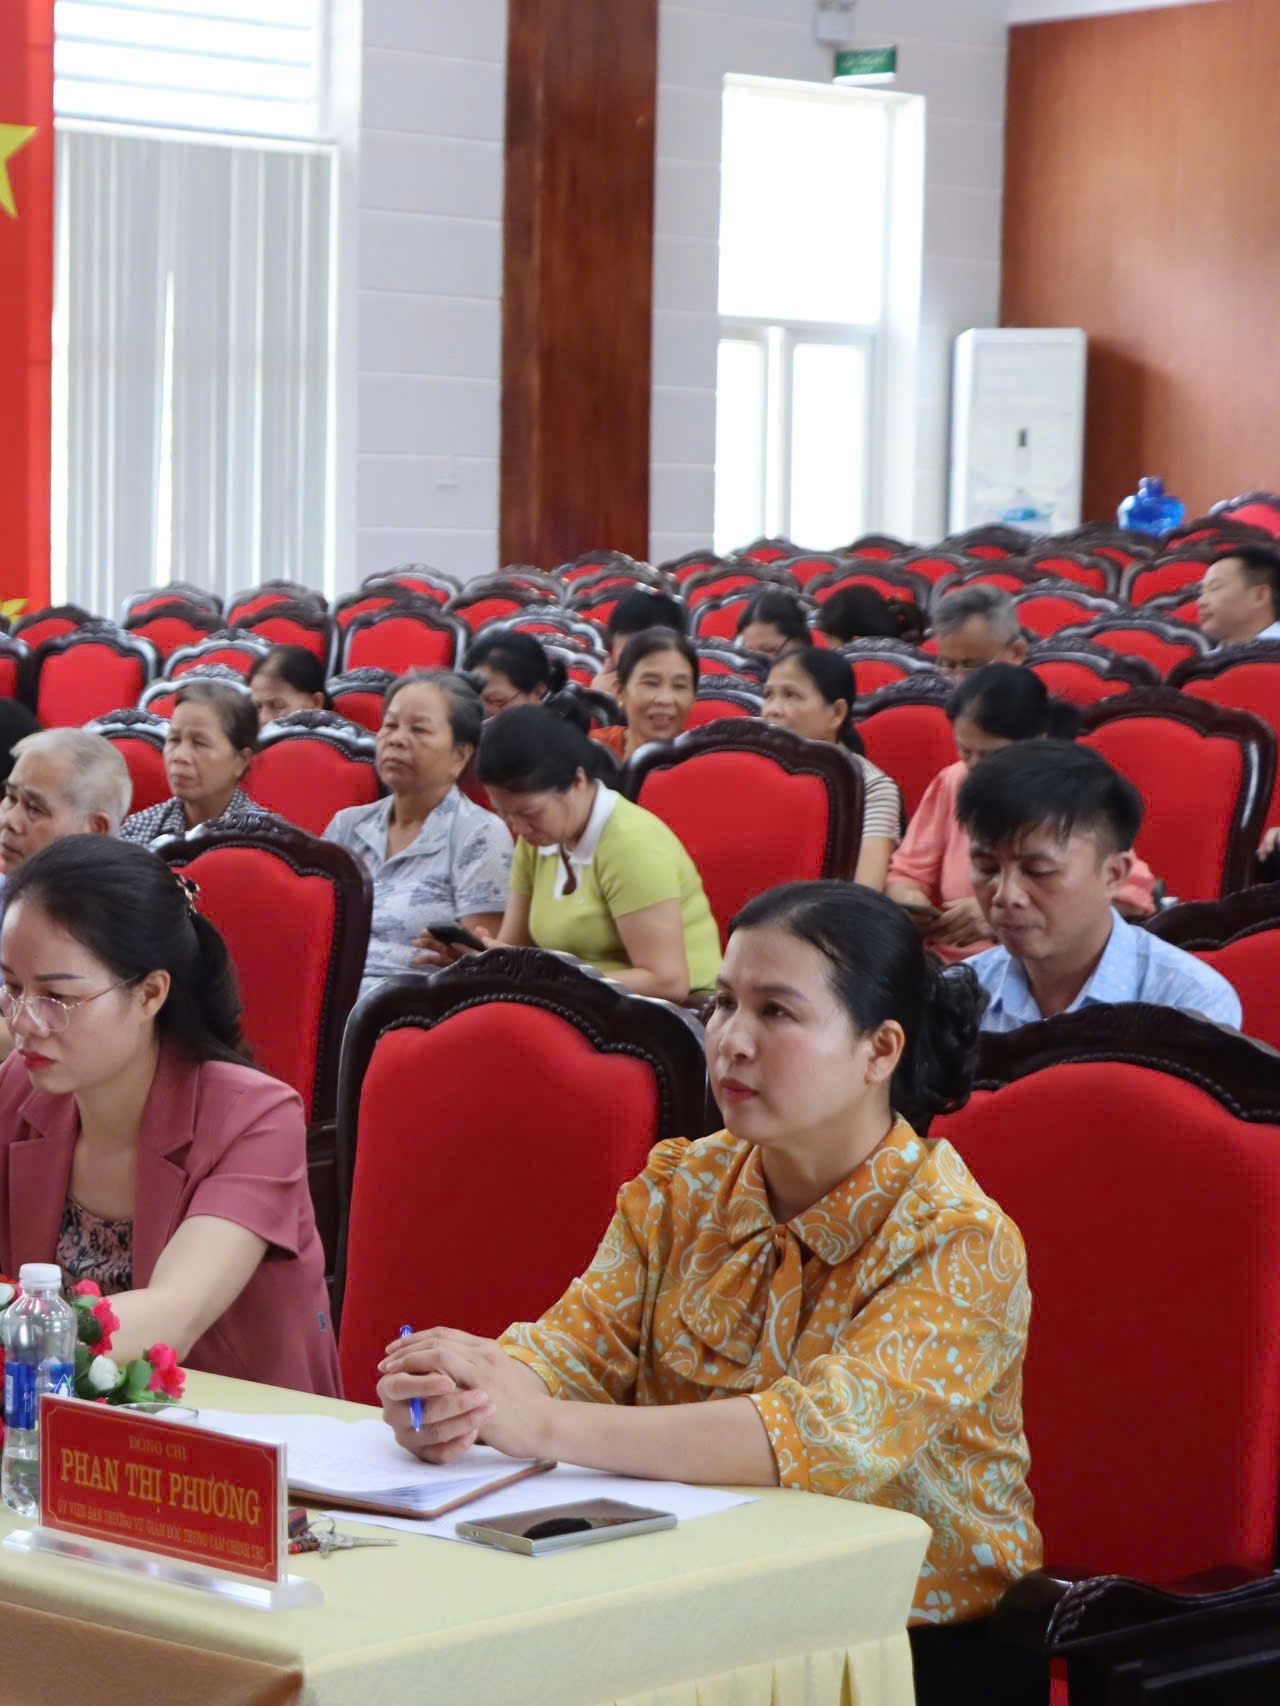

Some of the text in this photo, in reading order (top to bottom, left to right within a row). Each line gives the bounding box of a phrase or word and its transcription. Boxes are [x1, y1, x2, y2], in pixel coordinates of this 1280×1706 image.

[60, 1447, 261, 1525] PHAN THỊ PHƯƠNG
